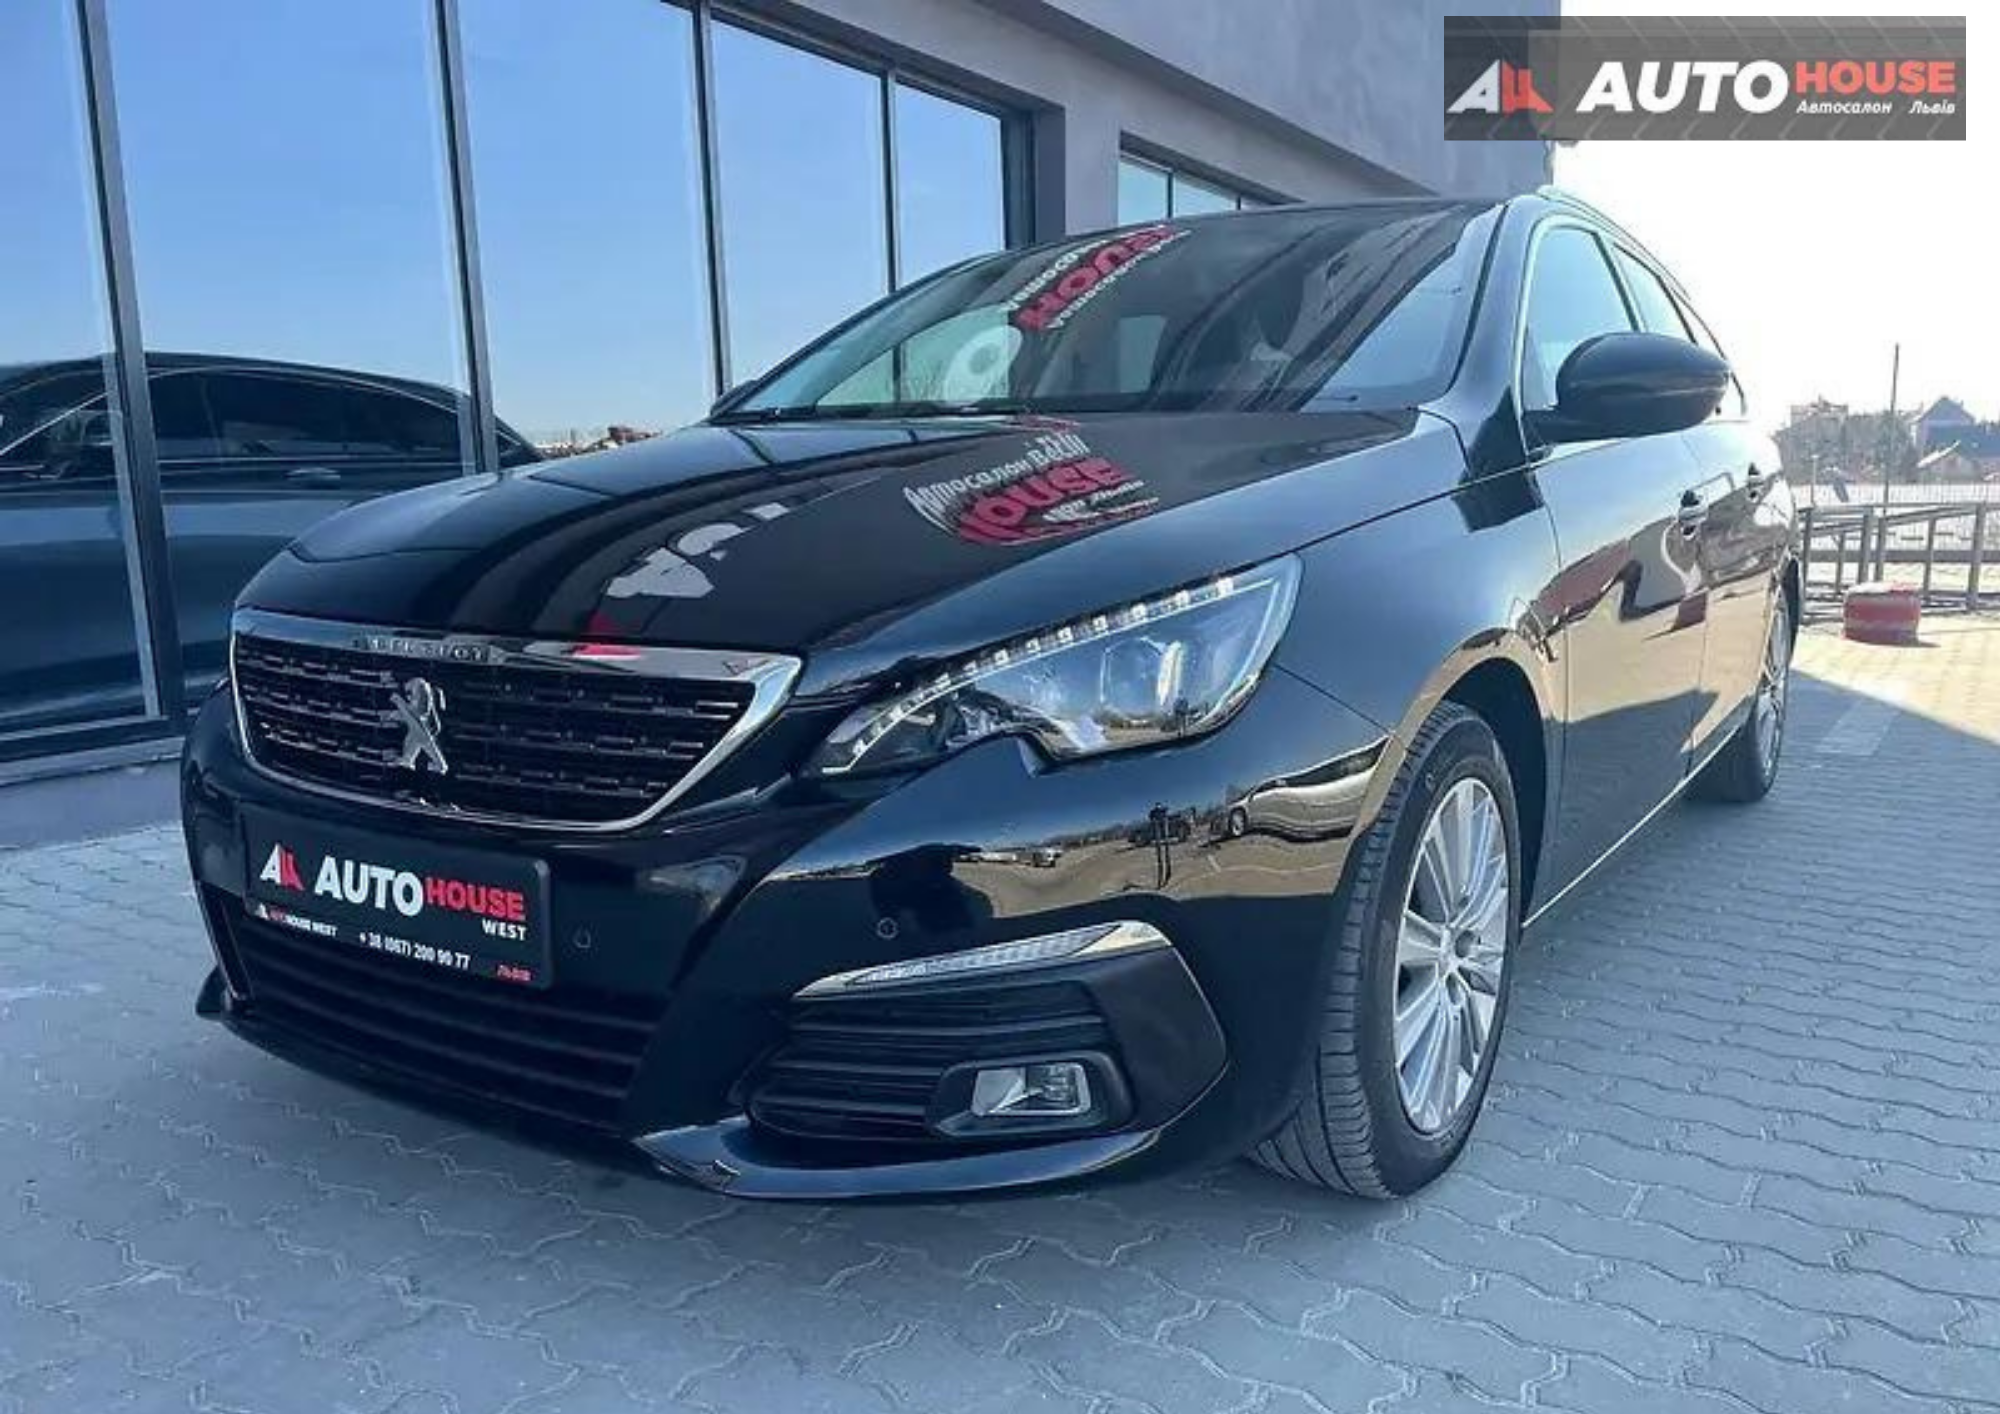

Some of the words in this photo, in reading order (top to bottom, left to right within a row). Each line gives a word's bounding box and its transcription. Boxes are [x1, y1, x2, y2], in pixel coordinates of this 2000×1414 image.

[314, 855, 423, 916] AUTO
[426, 877, 526, 921] HOUSE
[481, 919, 527, 941] WEST
[454, 953, 471, 970] 77
